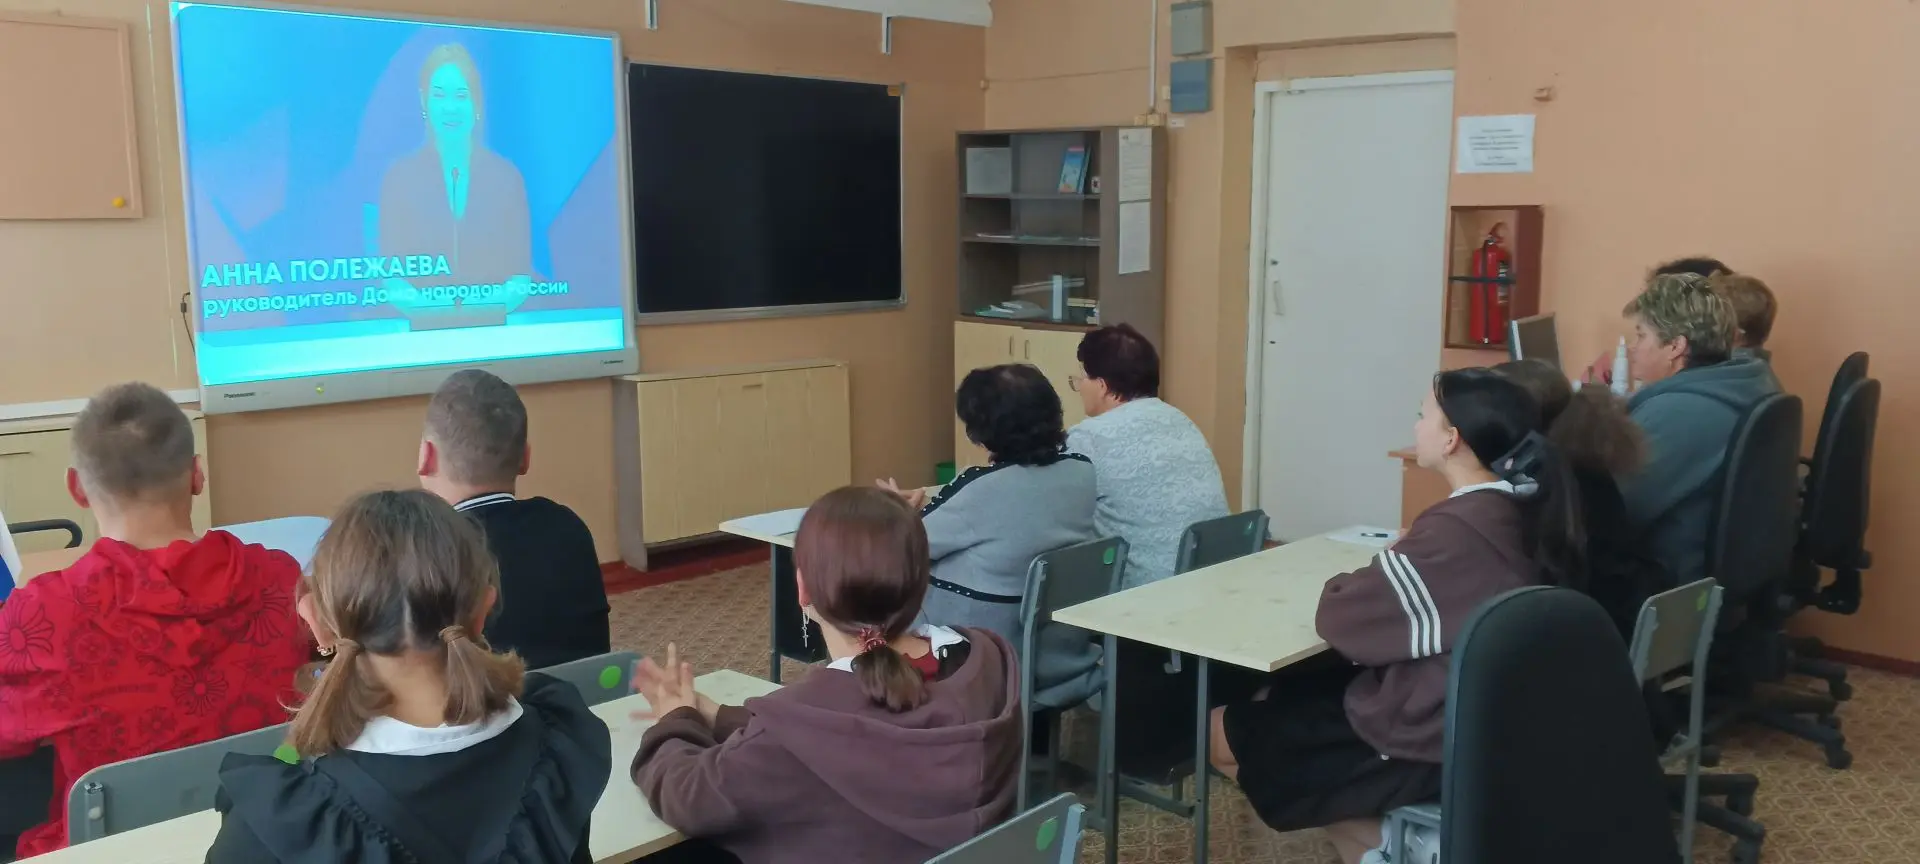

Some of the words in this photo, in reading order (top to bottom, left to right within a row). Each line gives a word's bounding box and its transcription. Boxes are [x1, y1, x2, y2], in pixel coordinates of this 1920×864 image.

[201, 262, 284, 288] АННА
[290, 254, 452, 282] ПОЛЕЖАЕВА
[203, 289, 358, 318] руководитель
